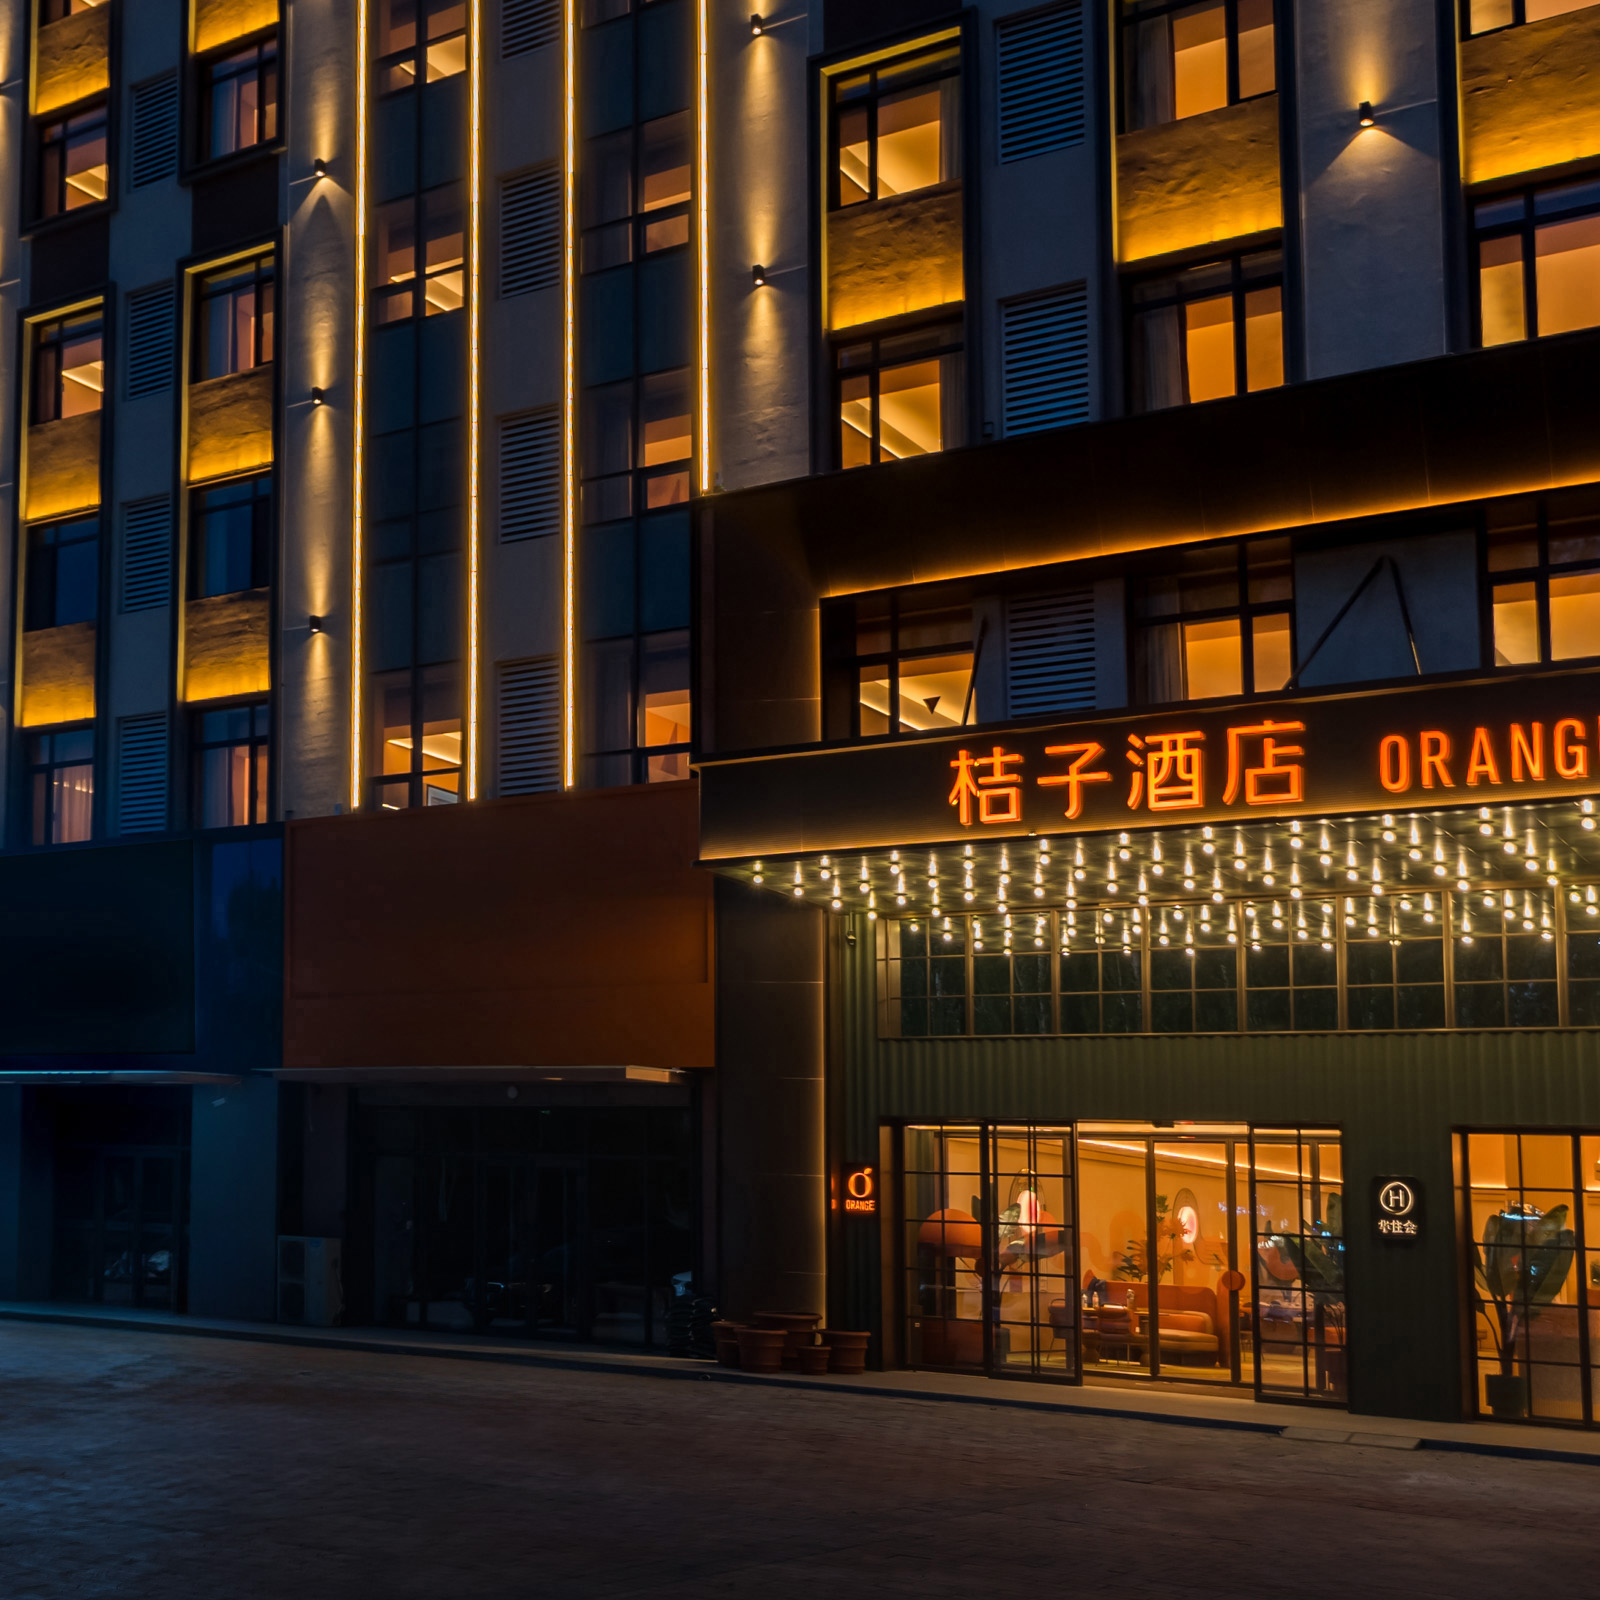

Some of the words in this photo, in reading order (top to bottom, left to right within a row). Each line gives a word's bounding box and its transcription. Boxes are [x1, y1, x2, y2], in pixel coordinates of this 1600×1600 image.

[948, 720, 1305, 826] 桔子酒店
[845, 1199, 876, 1211] ORANGE
[1377, 1219, 1418, 1235] 华住会
